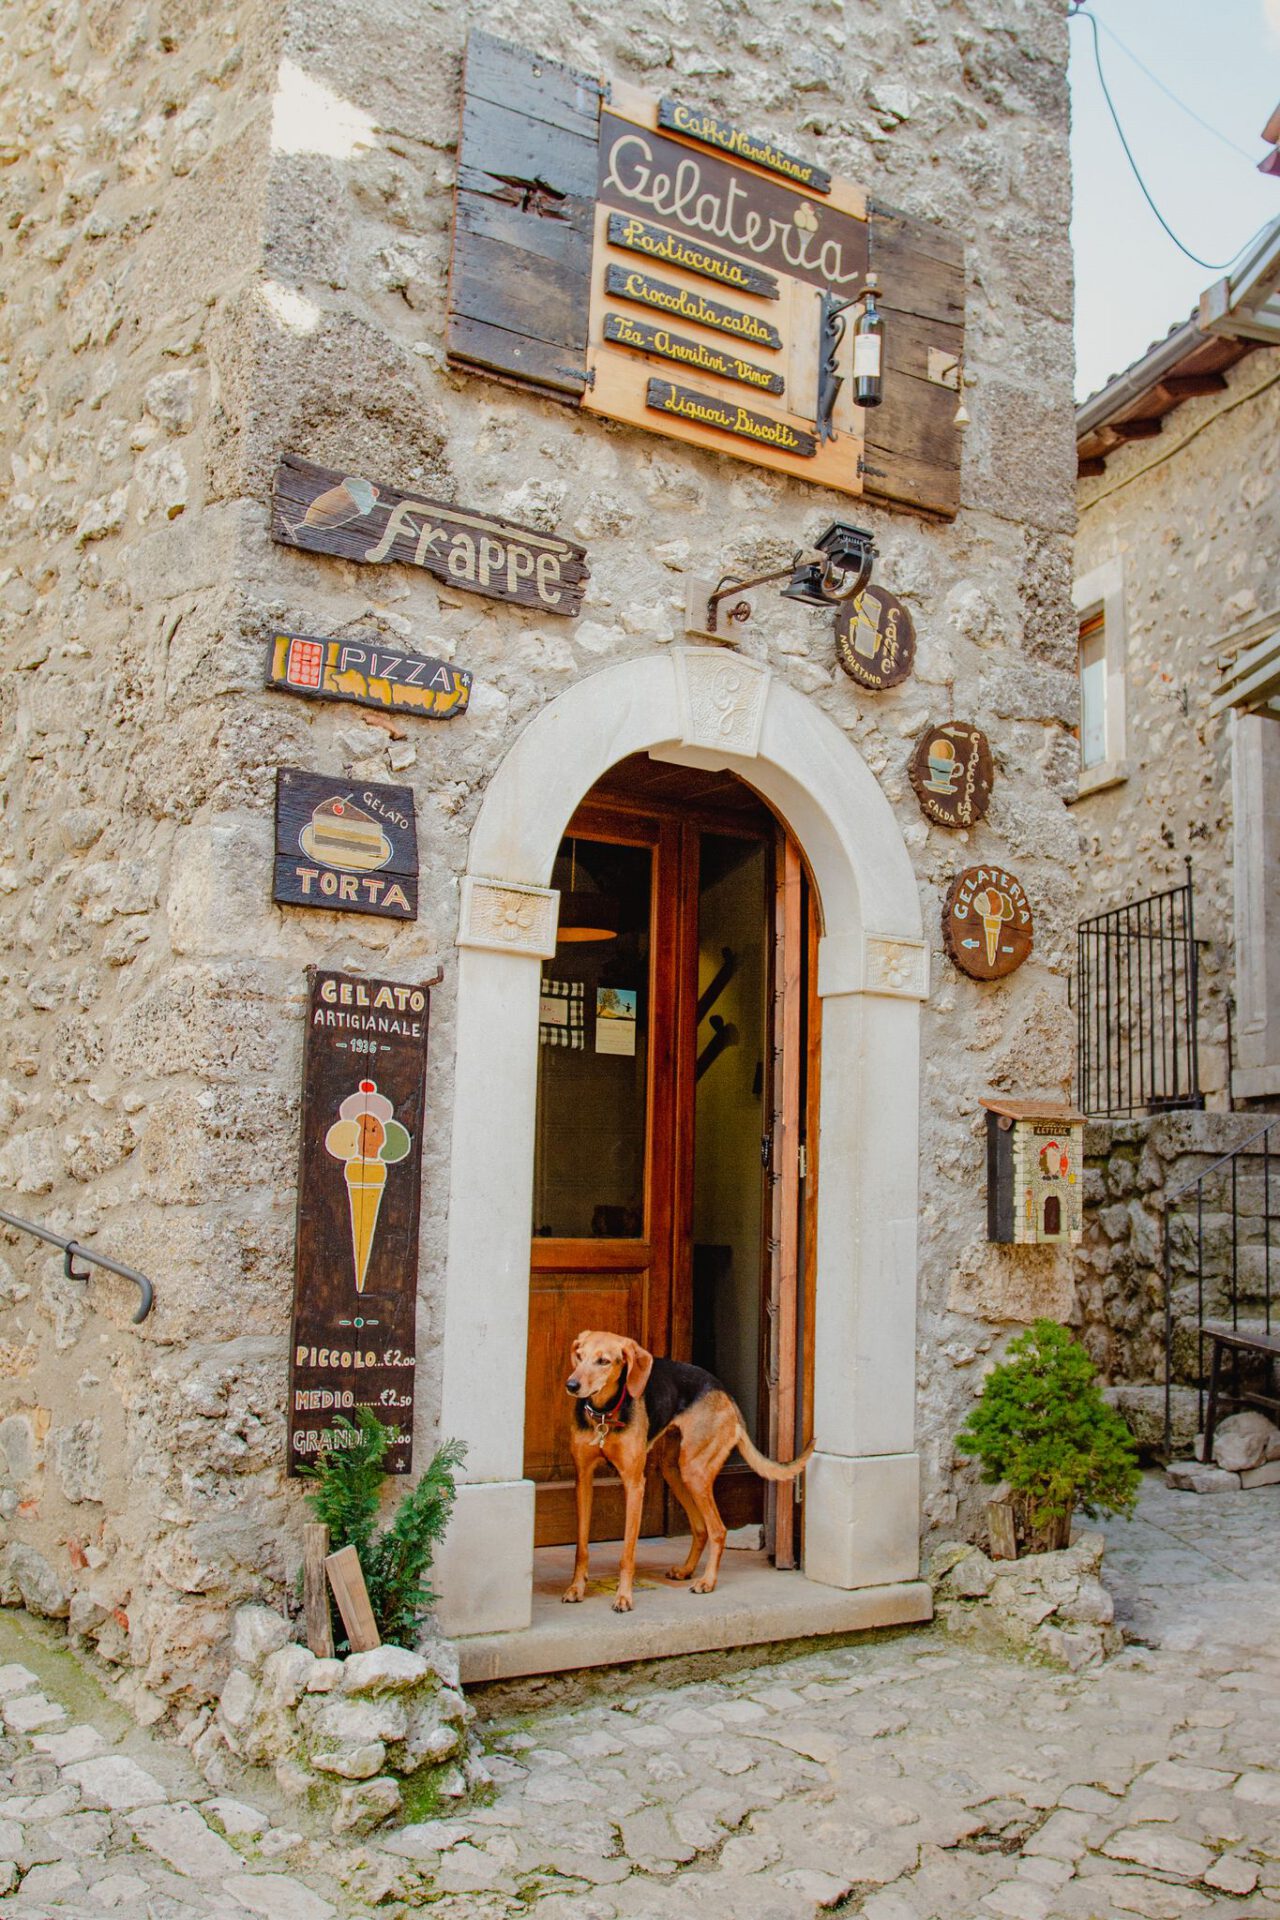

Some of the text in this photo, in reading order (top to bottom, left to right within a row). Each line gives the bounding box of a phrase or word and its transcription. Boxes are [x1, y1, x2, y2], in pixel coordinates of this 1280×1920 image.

[603, 135, 858, 283] Gelateria
[623, 220, 748, 285] Pasticceria
[624, 274, 772, 341] Cioccolata calda
[340, 647, 451, 691] PIZZA
[840, 634, 882, 684] NAPOLETANO
[363, 791, 409, 830] GELATO
[928, 799, 956, 823] CALDA
[296, 867, 411, 912] TORTA
[953, 869, 1031, 925] GELATERIA
[321, 979, 425, 1012] GELATO
[314, 1008, 421, 1038] ARTIGIANALE
